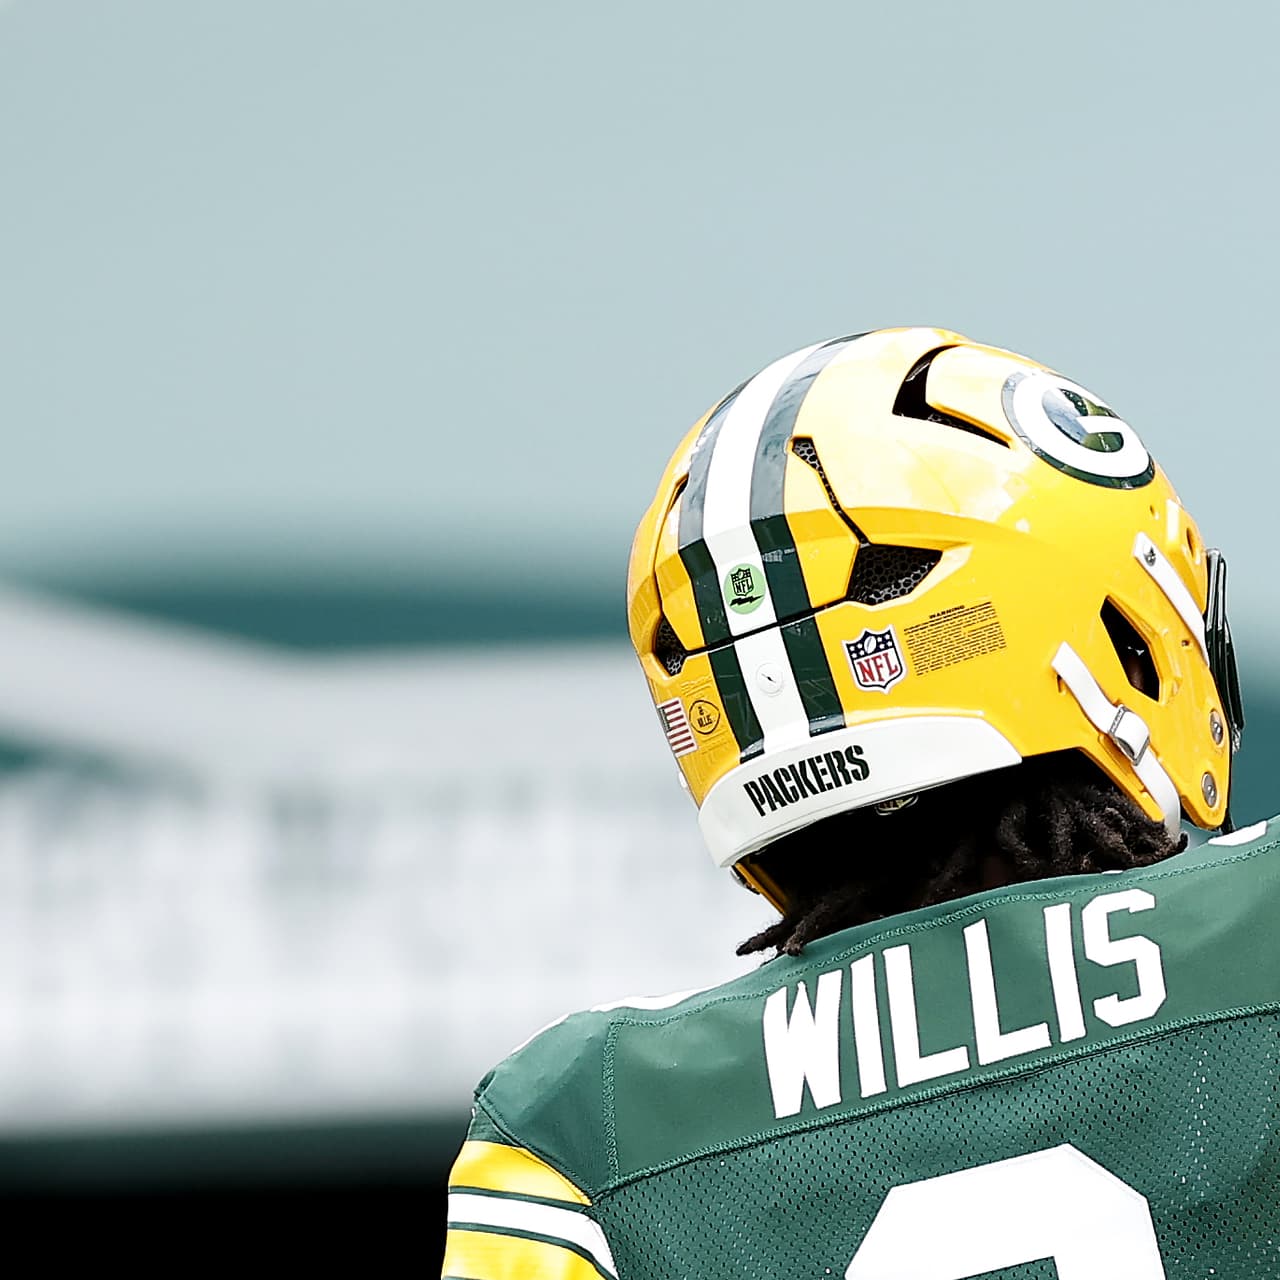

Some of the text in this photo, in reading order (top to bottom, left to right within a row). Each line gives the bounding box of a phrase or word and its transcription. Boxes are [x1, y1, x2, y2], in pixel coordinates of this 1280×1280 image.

[1013, 370, 1149, 478] G
[856, 651, 899, 683] NFL
[743, 745, 870, 817] PACKERS
[762, 888, 1168, 1119] WILLIS
